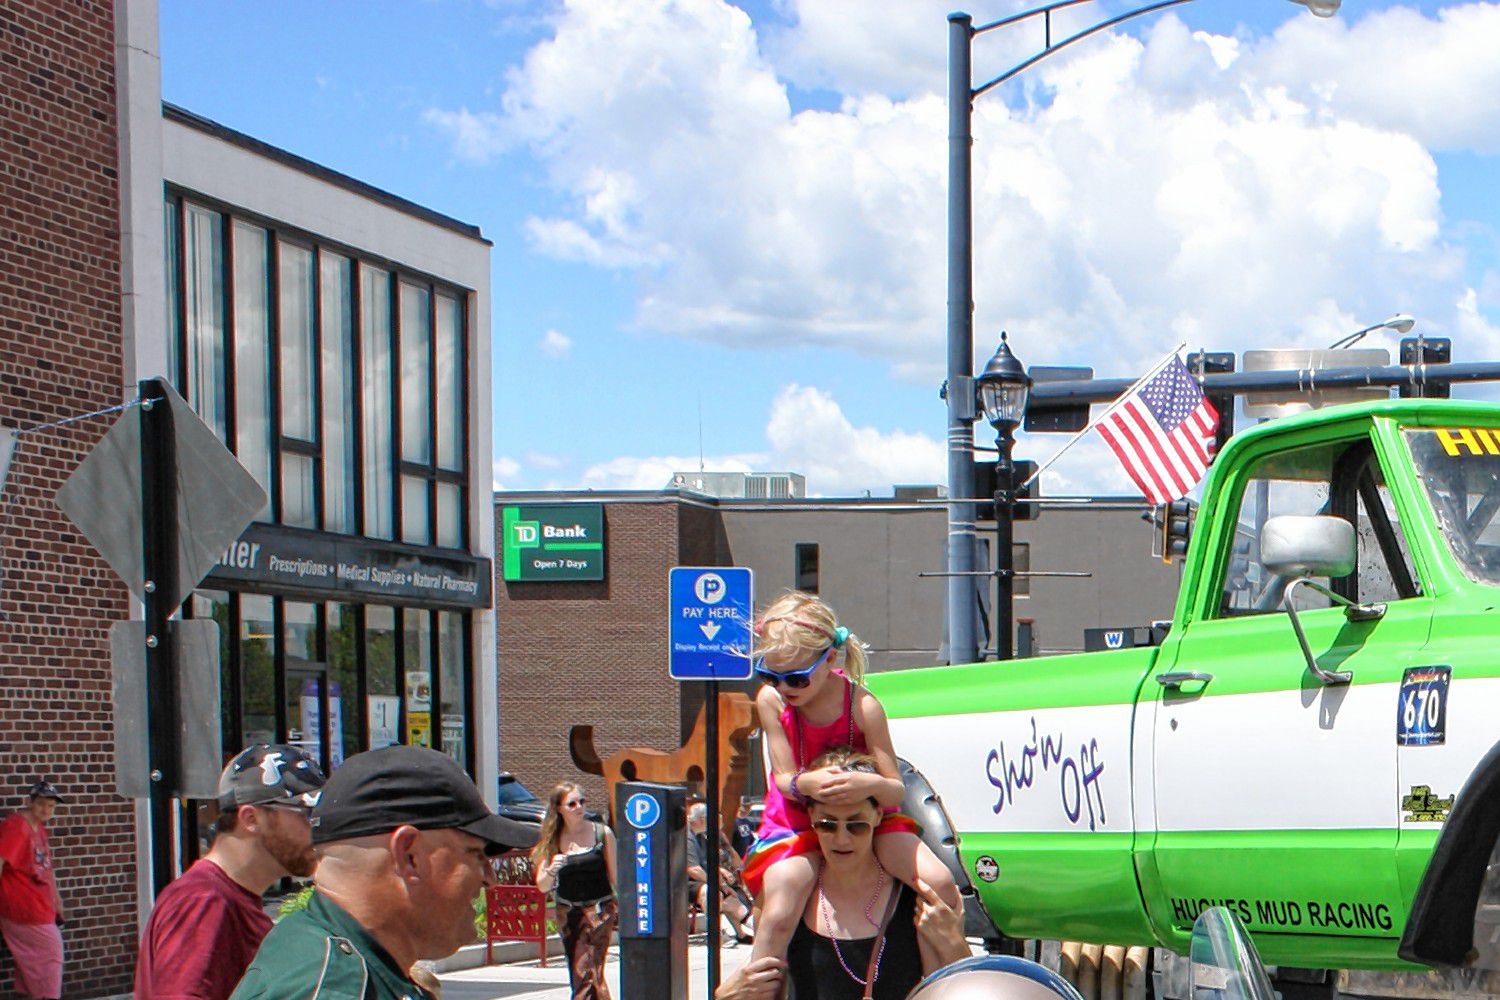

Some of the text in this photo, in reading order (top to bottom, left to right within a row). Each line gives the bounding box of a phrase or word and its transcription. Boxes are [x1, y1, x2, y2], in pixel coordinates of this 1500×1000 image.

[513, 525, 587, 542] TD Bank
[269, 555, 478, 595] Prescriptions Medical Supplies Natural Pharmacy
[534, 560, 557, 570] Open
[566, 560, 587, 570] Days
[682, 606, 740, 618] PAY HERE
[1404, 688, 1440, 730] 670
[1061, 737, 1105, 832] Off
[637, 832, 649, 931] PAY HERE
[1256, 899, 1301, 926] MUD
[1307, 901, 1393, 931] RACING
